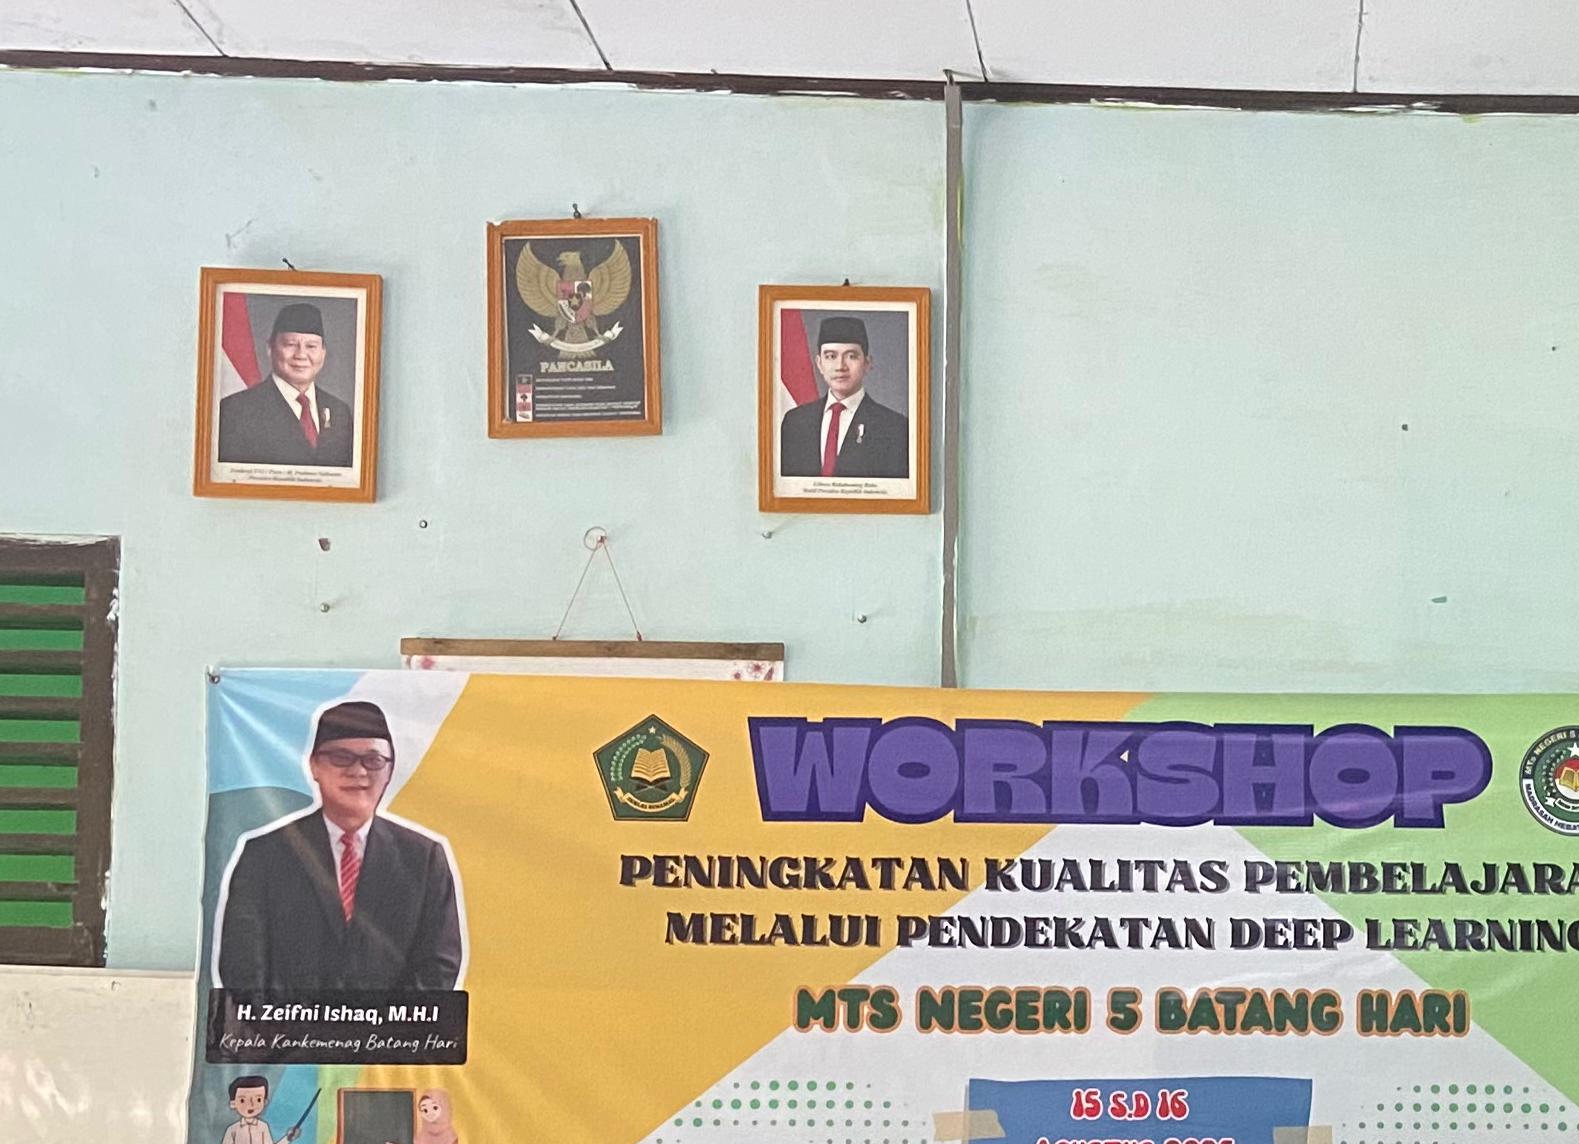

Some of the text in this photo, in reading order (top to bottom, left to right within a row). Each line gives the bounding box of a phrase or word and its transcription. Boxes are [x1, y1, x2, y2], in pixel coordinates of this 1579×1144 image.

[540, 360, 614, 373] PANCASILA
[748, 716, 1492, 828] WORKSHOP
[620, 854, 970, 891] PENINGKATAN
[984, 857, 1231, 893] KUALITAS
[665, 912, 882, 947] MELALUI
[896, 915, 1215, 950] PENDEKATAN
[1229, 917, 1354, 950] DEEP
[237, 1004, 439, 1025] H. Zeifni Ishaq, M.H.I
[793, 985, 1471, 1038] MTS NEGERI 5 BATANG HARI
[219, 1032, 459, 1053] Kepala Kankemenag Batang Hari
[1070, 1089, 1188, 1121] 15 S.D 16
